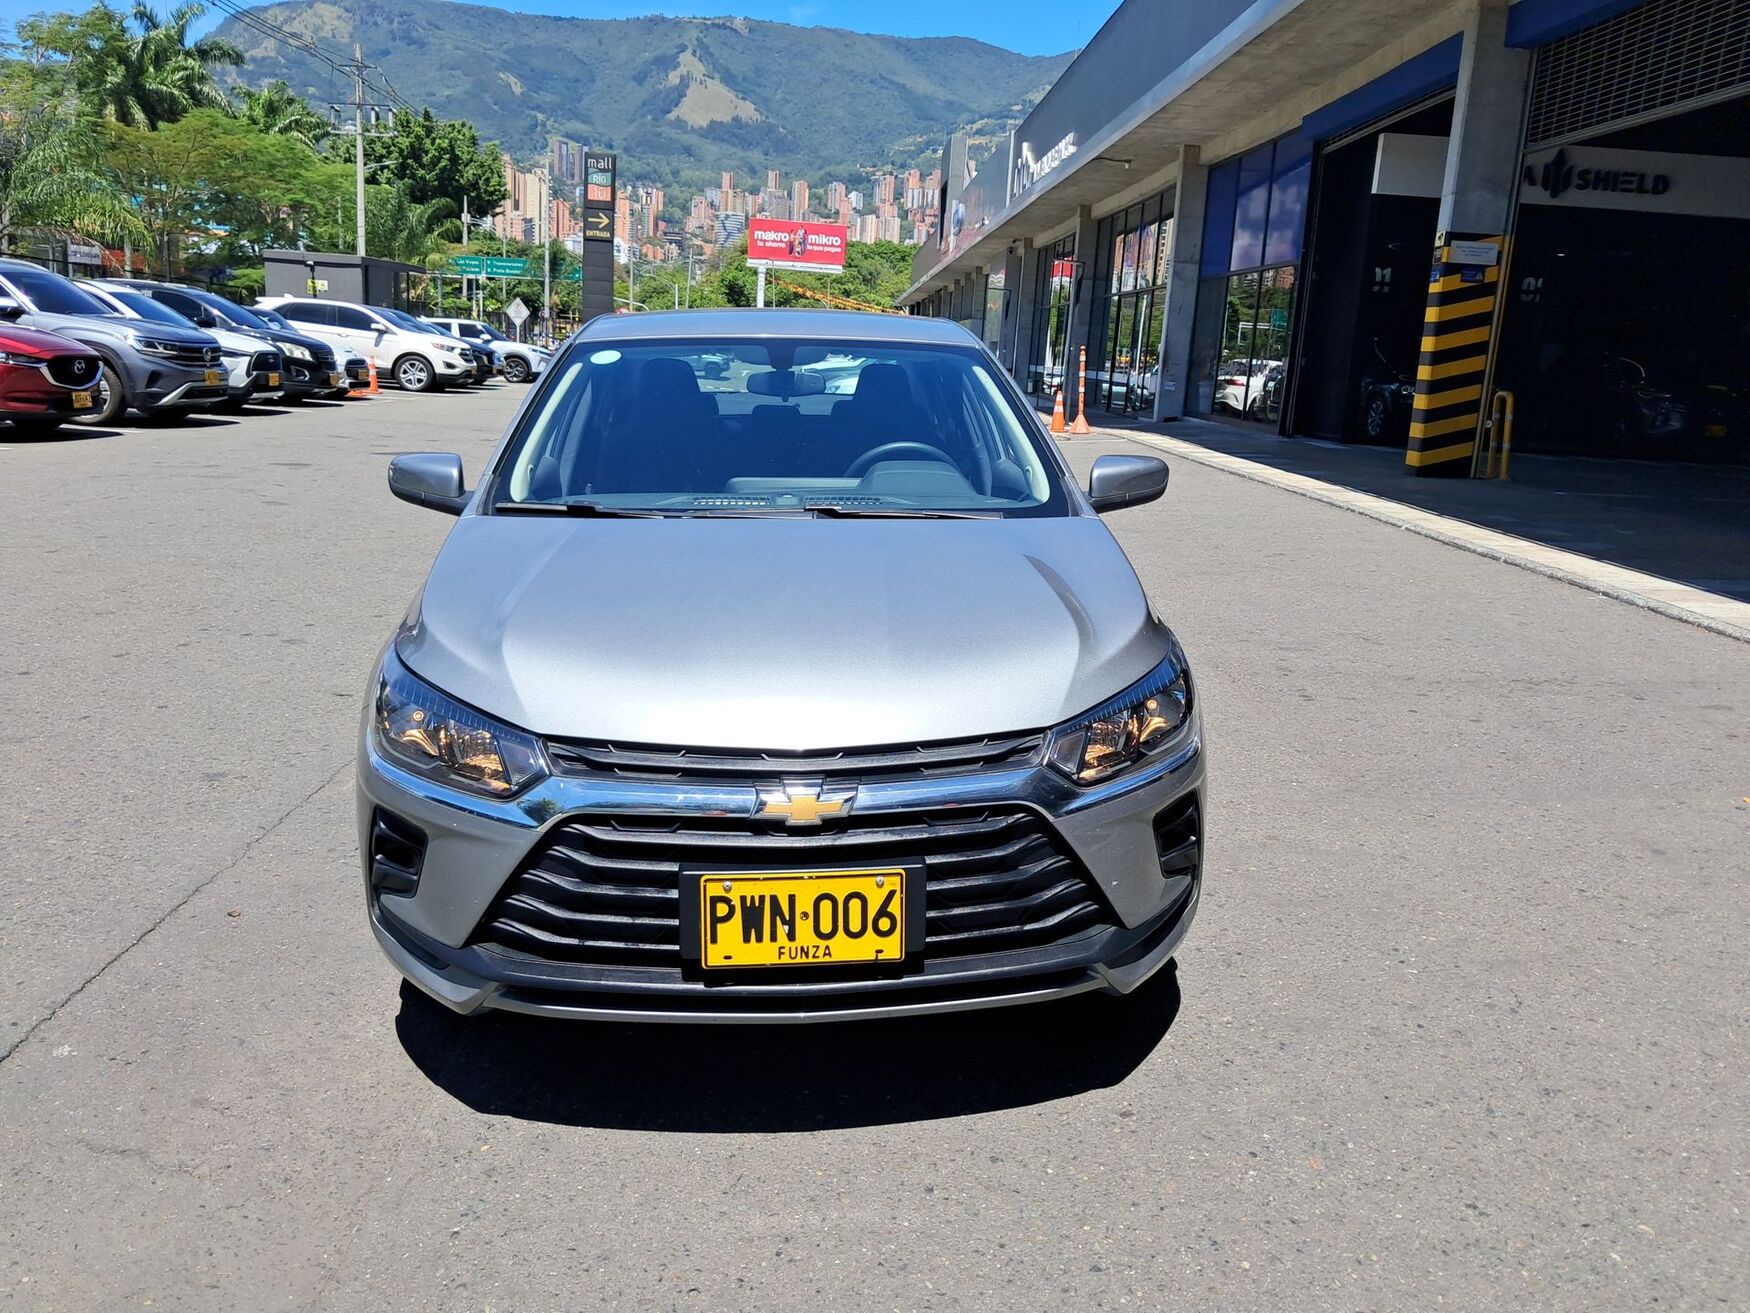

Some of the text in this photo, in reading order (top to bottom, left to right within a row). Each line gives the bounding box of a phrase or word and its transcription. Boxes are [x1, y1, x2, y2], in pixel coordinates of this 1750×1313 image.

[588, 157, 612, 169] mall
[1575, 168, 1671, 195] SHIELD
[585, 229, 611, 238] ENTRADA
[754, 230, 790, 242] makro
[808, 233, 841, 246] mikro
[765, 241, 786, 249] ahorro
[778, 945, 832, 960] FUNZA
